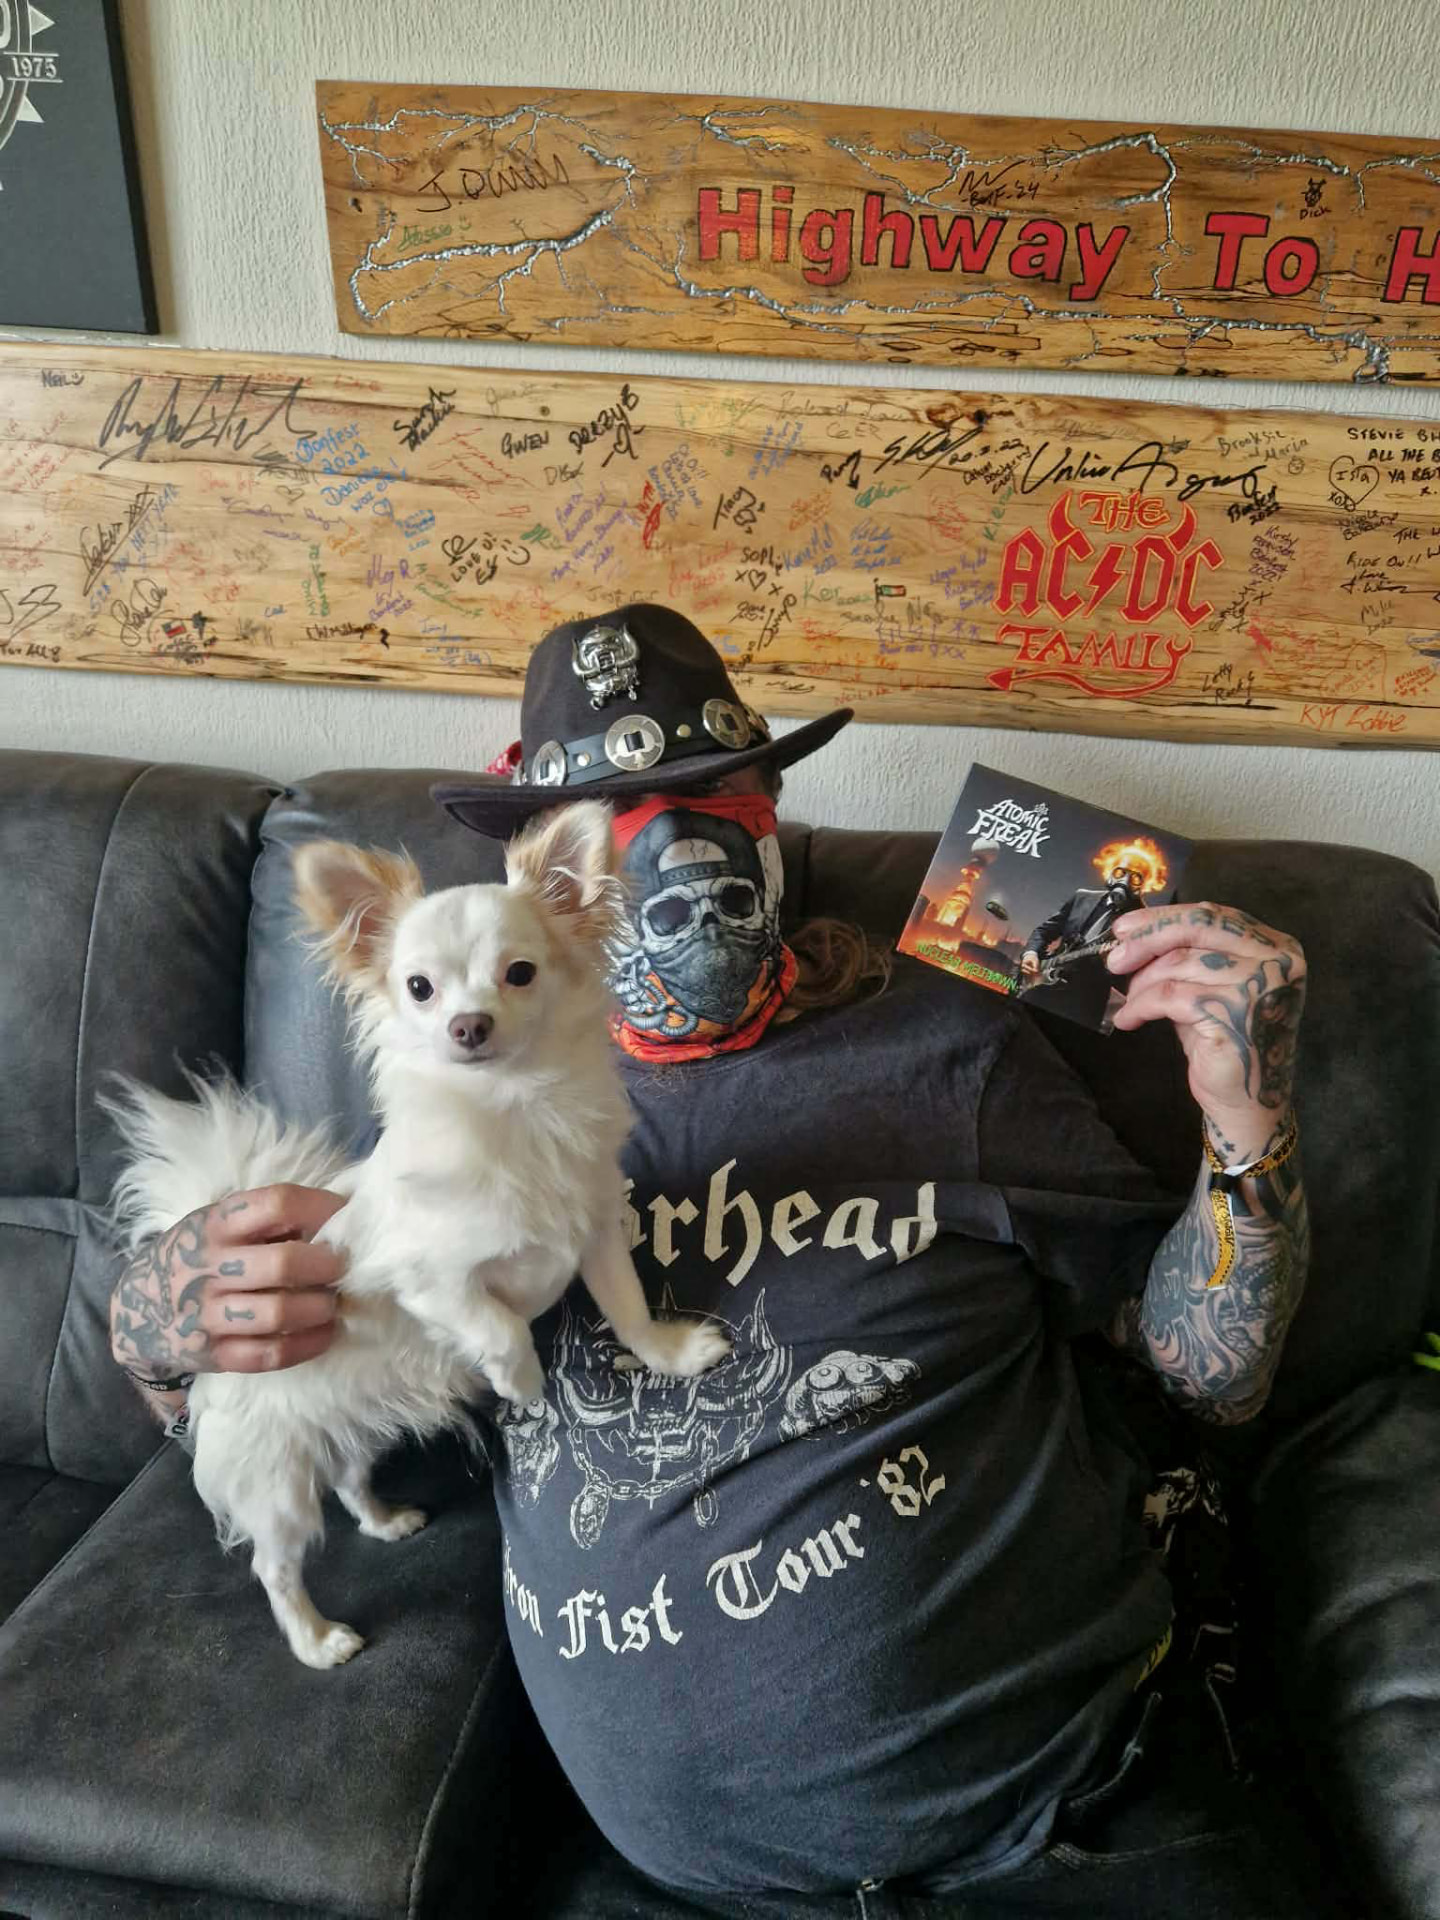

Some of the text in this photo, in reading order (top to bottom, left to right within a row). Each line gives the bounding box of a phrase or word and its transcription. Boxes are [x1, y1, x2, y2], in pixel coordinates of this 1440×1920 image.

[12, 56, 57, 78] 1975
[697, 185, 1131, 301] Highway
[1204, 211, 1320, 297] To
[1347, 426, 1405, 440] STEVIE
[1367, 448, 1396, 462] ALL
[1401, 448, 1426, 462] THE
[1388, 468, 1406, 485] YA
[1078, 489, 1171, 533] THE
[991, 526, 1225, 631] AC/DC
[996, 621, 1194, 674] FAMILY
[967, 809, 1051, 859] FREAK
[985, 799, 1051, 833] ATOMIC
[915, 943, 1018, 991] NUCLEAR MELTDOWN
[557, 1572, 684, 1660] Fist
[705, 1513, 867, 1621] Tour
